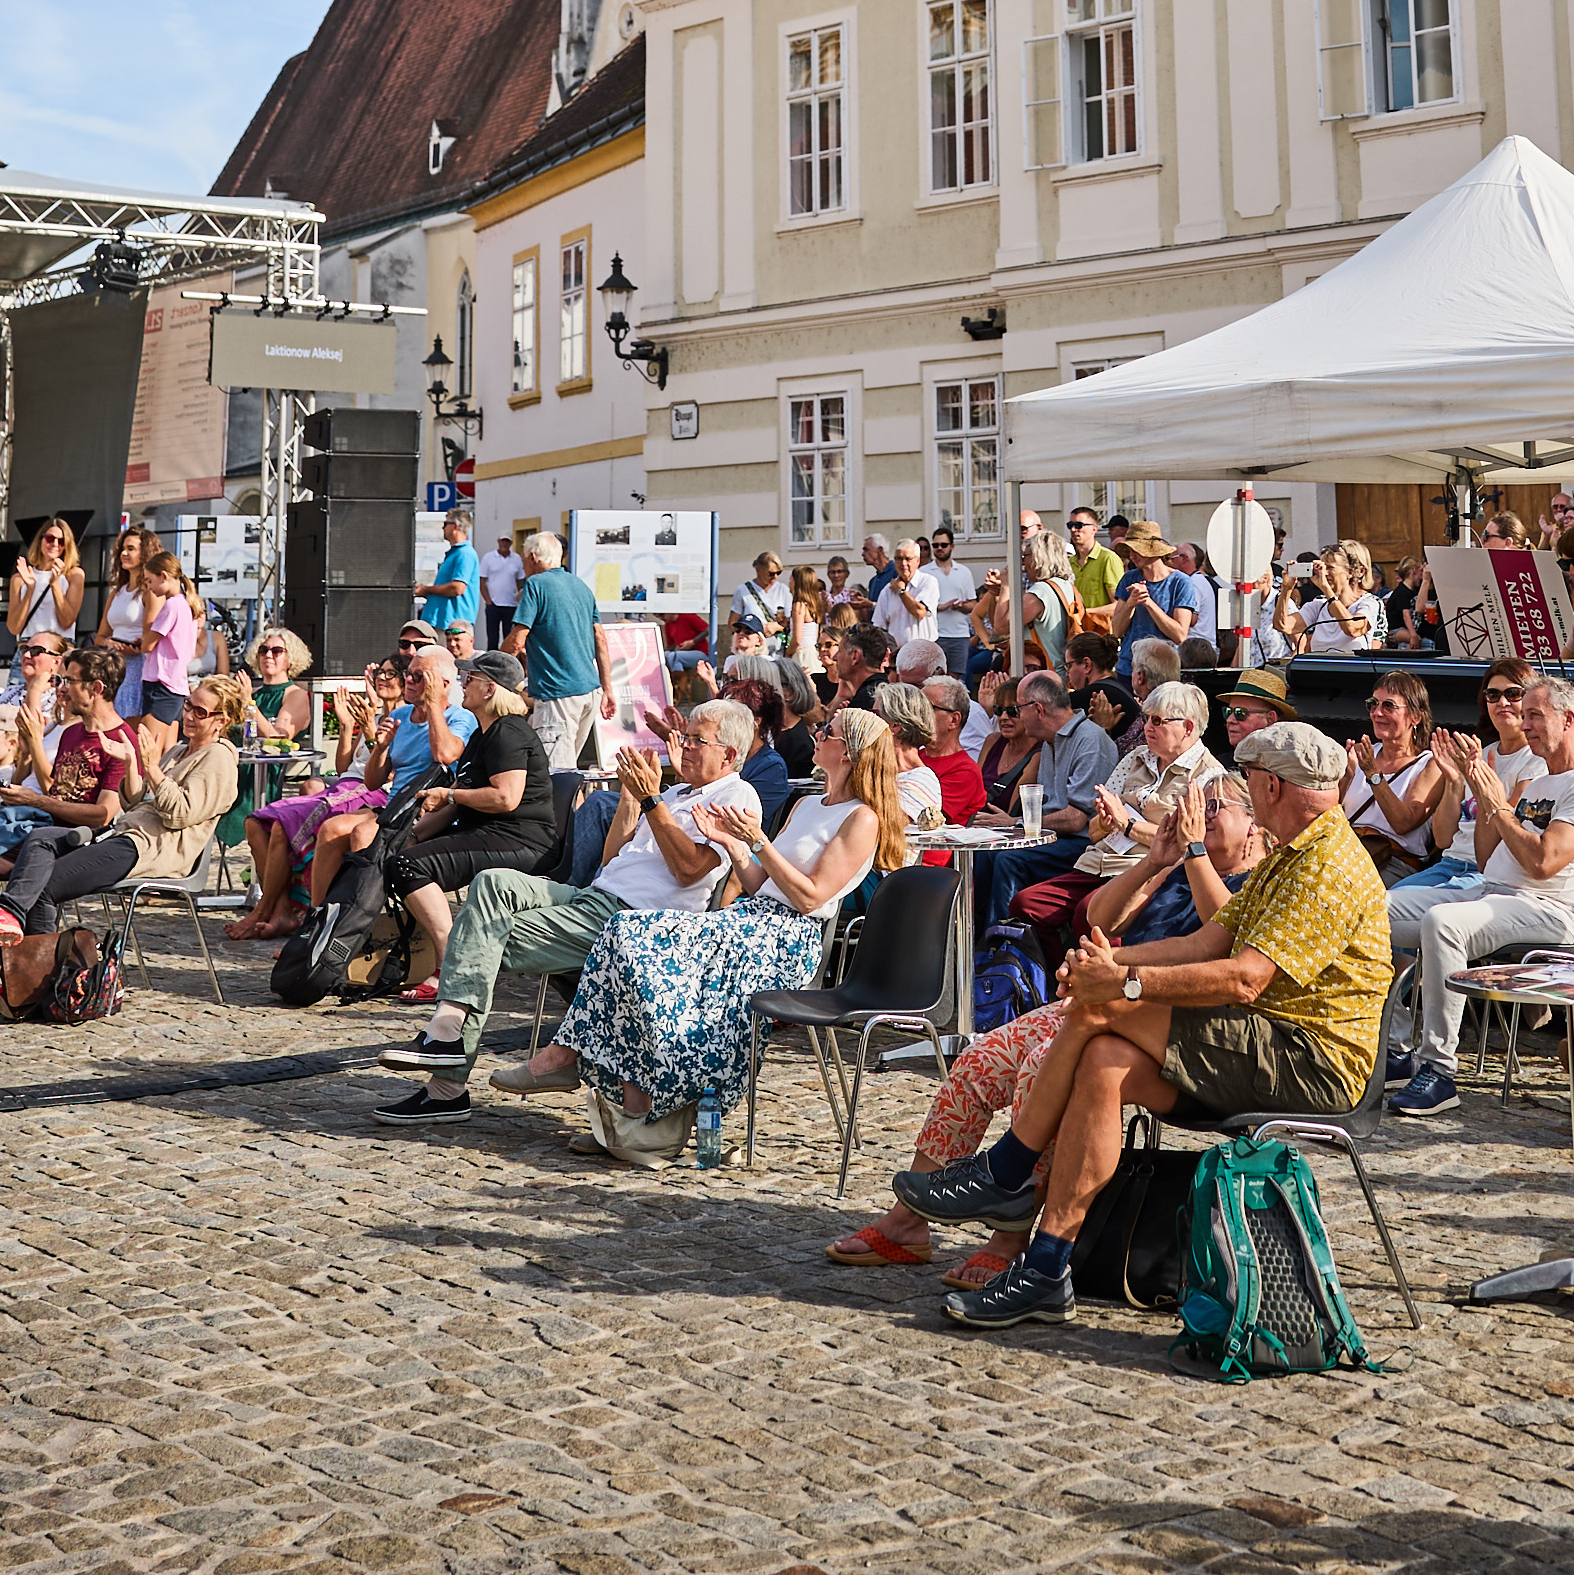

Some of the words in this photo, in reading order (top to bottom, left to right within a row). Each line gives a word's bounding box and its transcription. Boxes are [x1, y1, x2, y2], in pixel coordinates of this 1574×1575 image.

[265, 344, 311, 358] Laktionow
[312, 347, 343, 362] Aleksej
[433, 484, 451, 511] P
[1482, 584, 1496, 614] MELK
[1518, 572, 1539, 603] 722
[1505, 580, 1537, 659] MIETEN
[1529, 609, 1545, 630] 68
[1537, 635, 1553, 657] 83
